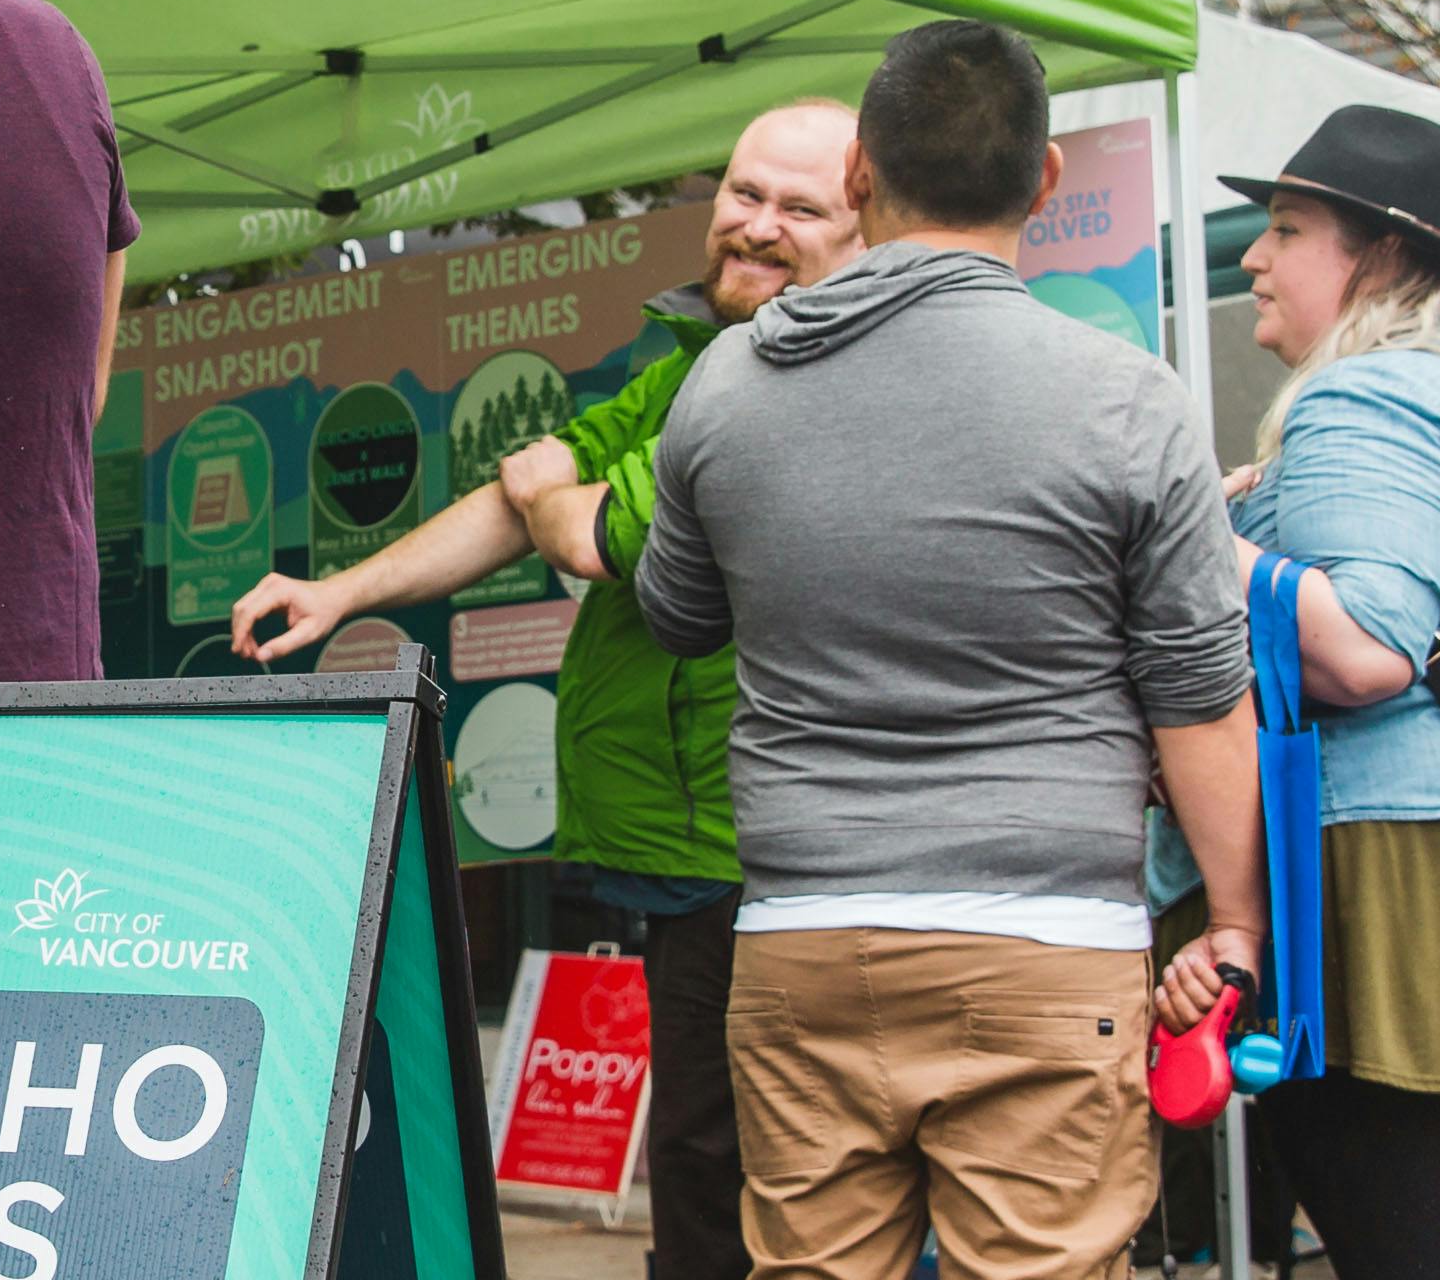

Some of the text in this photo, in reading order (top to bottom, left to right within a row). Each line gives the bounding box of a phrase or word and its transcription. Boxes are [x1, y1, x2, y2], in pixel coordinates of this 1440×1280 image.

[1022, 209, 1113, 247] OLVED
[1065, 188, 1112, 213] STAY
[446, 225, 643, 297] EMERGING
[154, 270, 385, 350] ENGAGEMENT
[445, 294, 580, 353] THEMES
[153, 338, 323, 403] SNAPSHOT
[74, 912, 165, 935] CITY OF
[39, 936, 249, 972] VANCOUVER
[523, 1037, 649, 1092] Poppy
